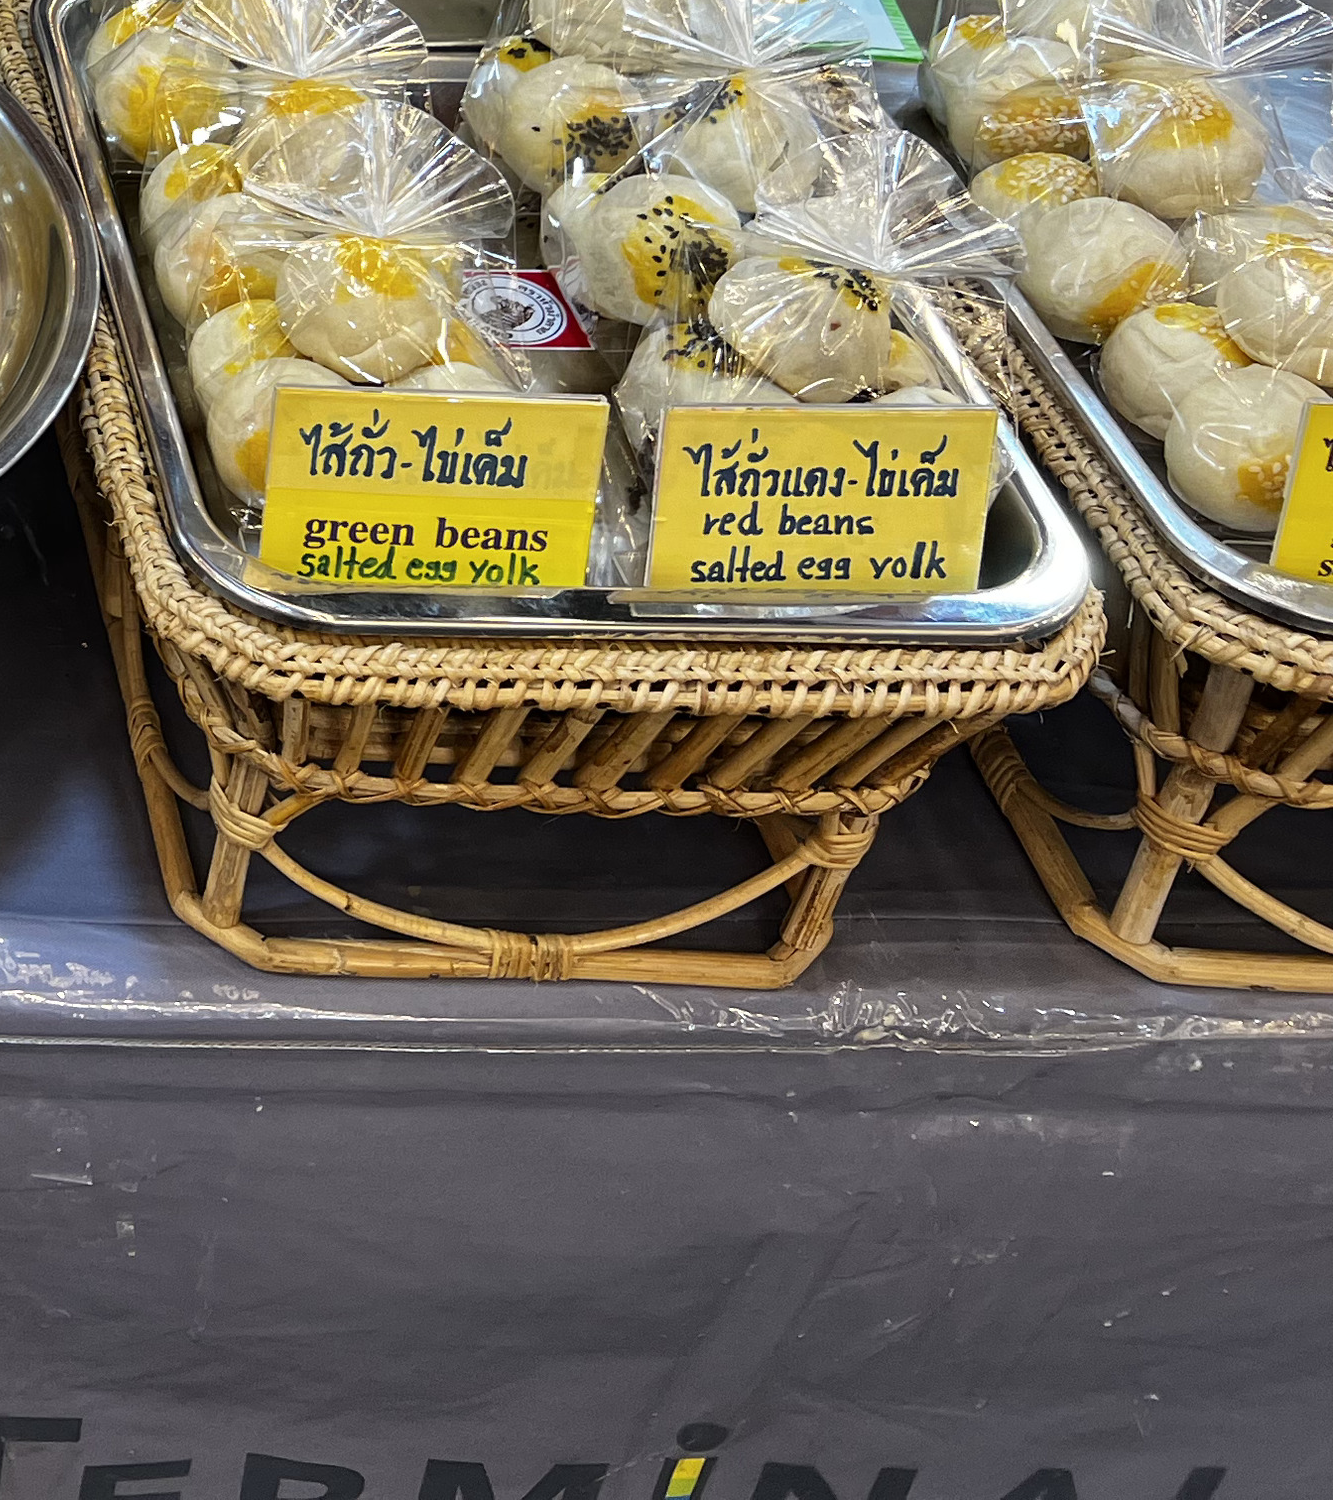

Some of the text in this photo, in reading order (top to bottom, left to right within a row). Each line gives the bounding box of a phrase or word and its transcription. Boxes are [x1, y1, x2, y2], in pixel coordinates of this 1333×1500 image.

[303, 517, 548, 552] green beans
[703, 501, 875, 535] red beans
[297, 546, 540, 586] salted egg yolk
[690, 541, 947, 583] salted egg yolk
